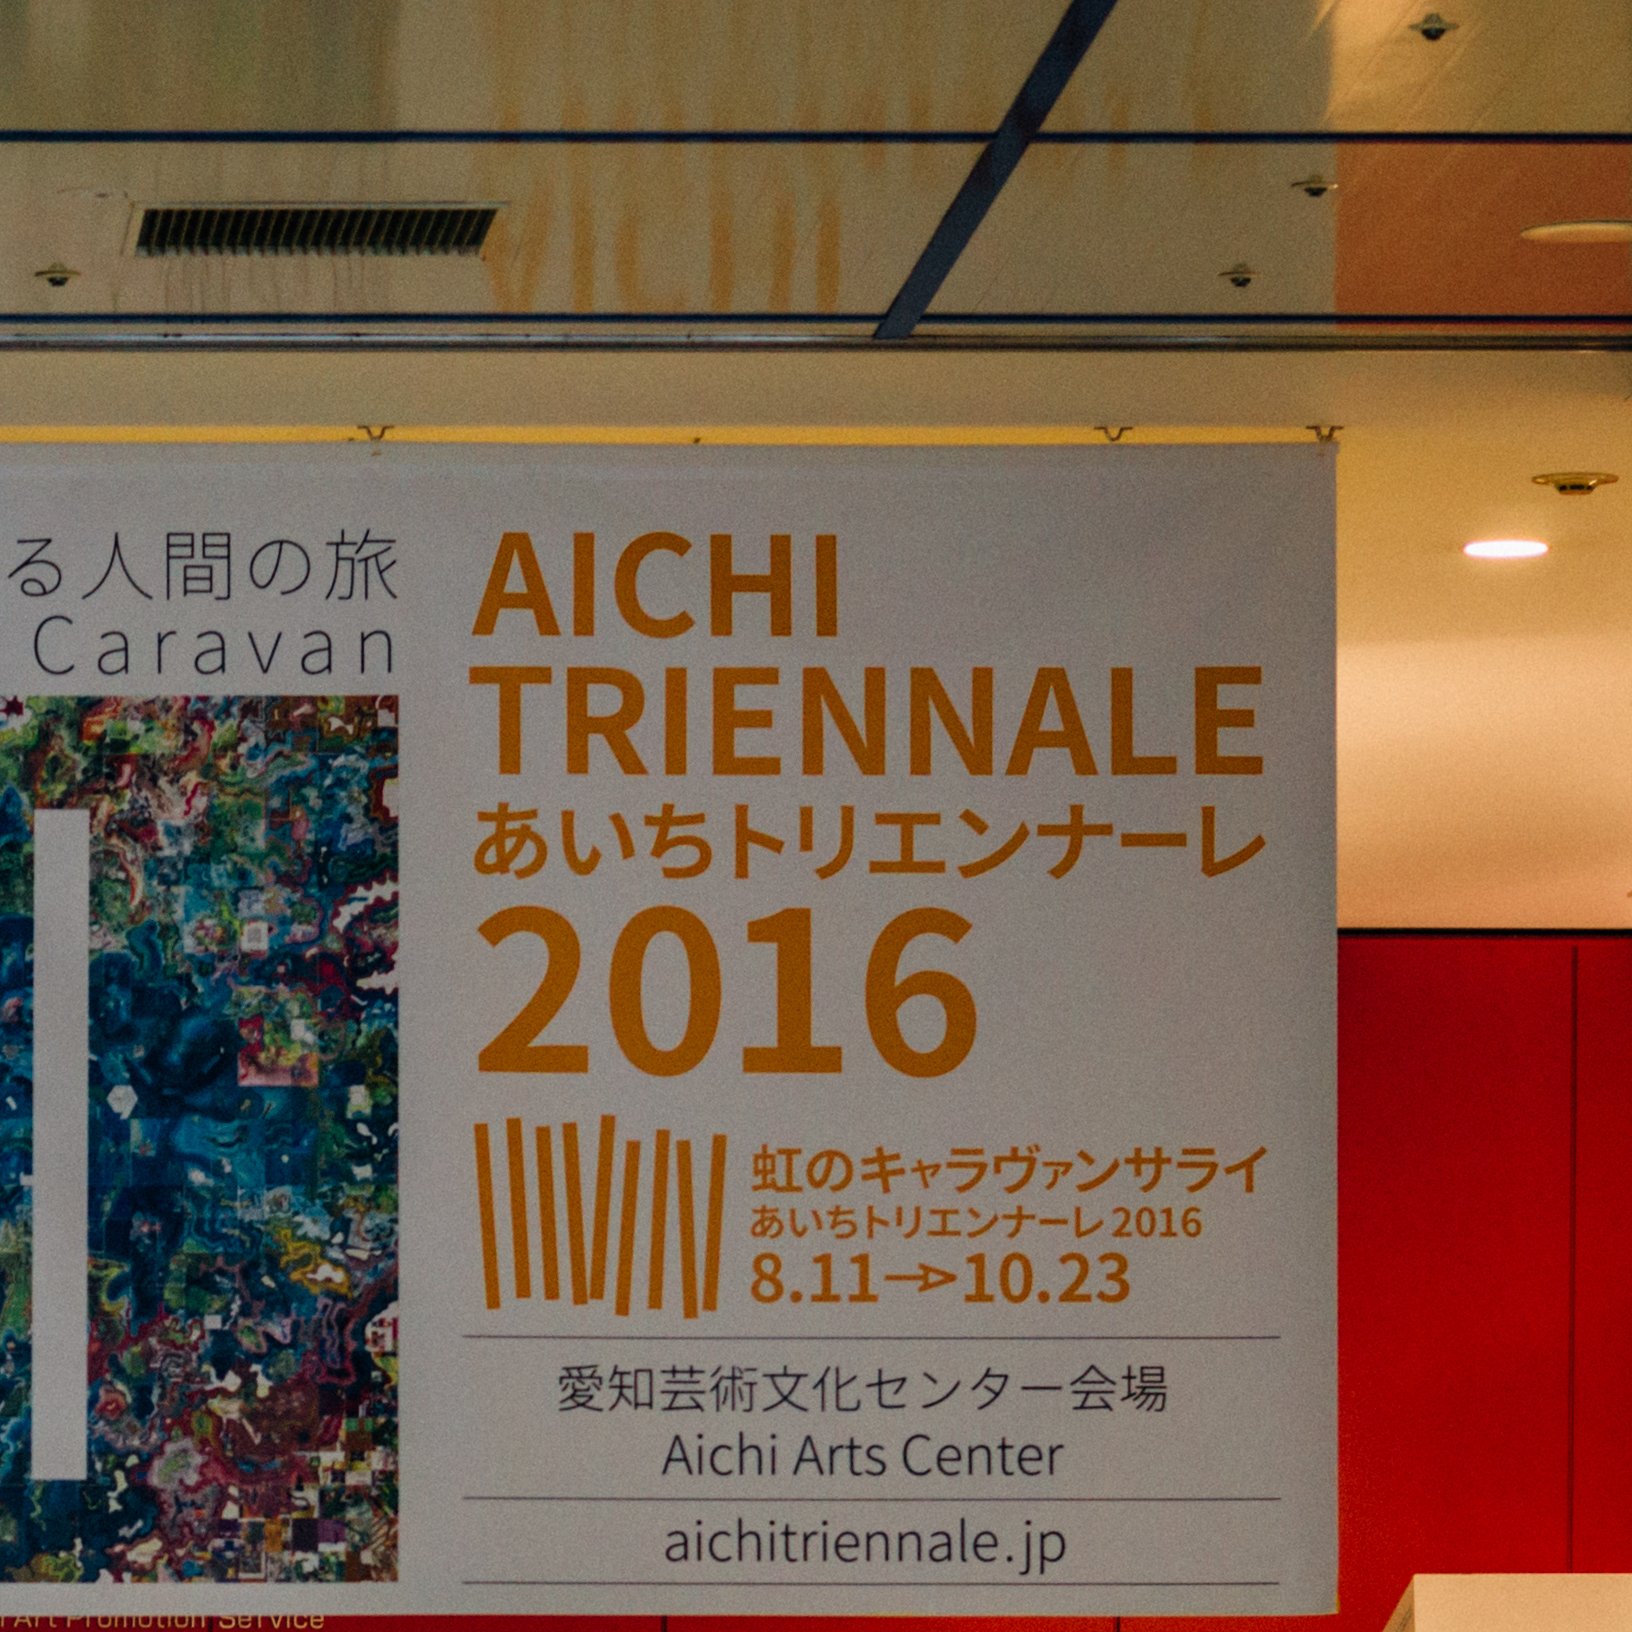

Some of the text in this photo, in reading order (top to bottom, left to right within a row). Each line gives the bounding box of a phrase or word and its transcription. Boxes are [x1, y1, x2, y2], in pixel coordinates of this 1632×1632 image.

[471, 530, 838, 638] AICHI
[34, 614, 395, 677] Caravan
[469, 665, 1265, 777] TRIENNALE
[473, 802, 1268, 880] あいちトリエンナーレ
[477, 904, 978, 1080] 2016
[750, 1144, 1270, 1195] 虹のキャラヴァンサライ
[750, 1203, 1204, 1239] あいちトリエンナーレ2016
[557, 1362, 1170, 1415] 愛知芸術文化センター会場
[661, 1431, 1065, 1478] Aichi Arts Center
[664, 1516, 1068, 1577] aichitriennale.jp
